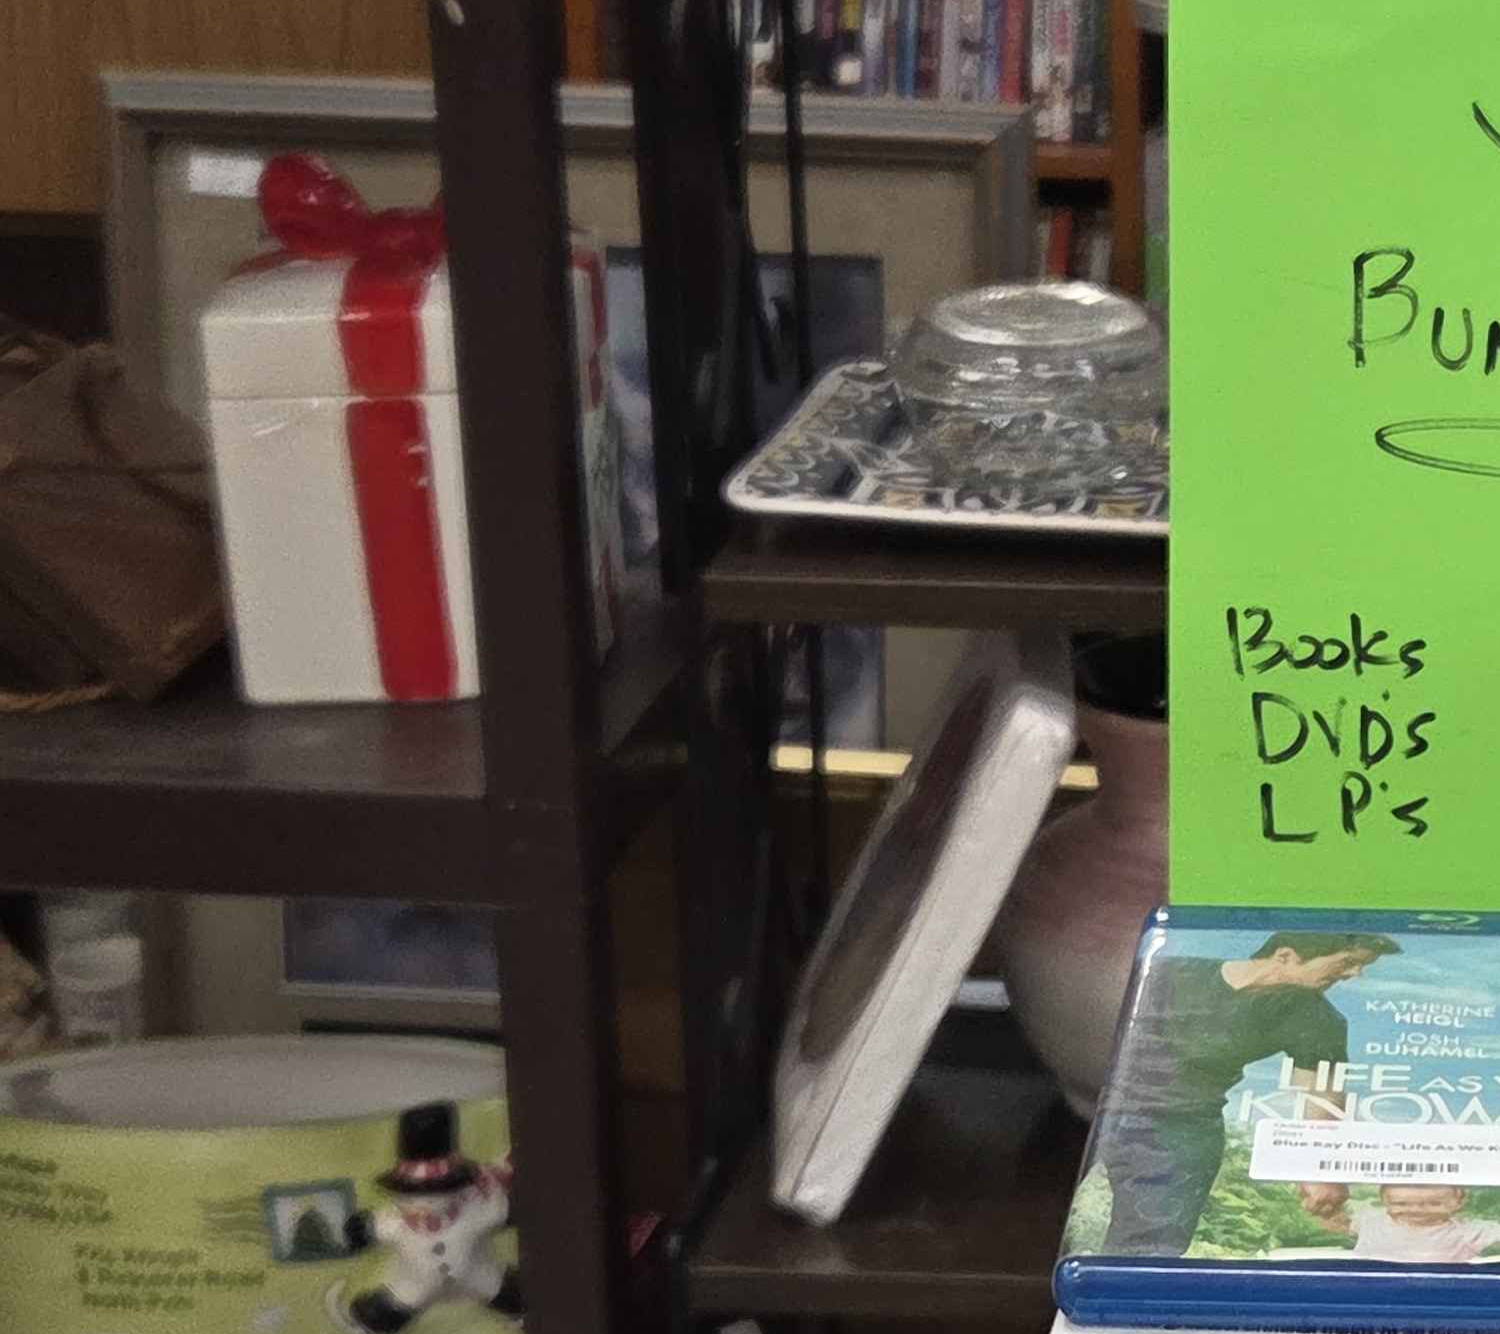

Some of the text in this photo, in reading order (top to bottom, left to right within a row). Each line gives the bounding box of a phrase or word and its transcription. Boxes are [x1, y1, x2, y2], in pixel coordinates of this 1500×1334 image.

[1226, 606, 1428, 678] Books
[1365, 999, 1497, 1018] KATHERINE
[1394, 1013, 1465, 1029] HEIGL
[1397, 1032, 1460, 1046] JOSH
[1365, 1043, 1489, 1059] DUHAMEL
[1278, 1057, 1412, 1092] LIFE
[1420, 1075, 1483, 1094] AS
